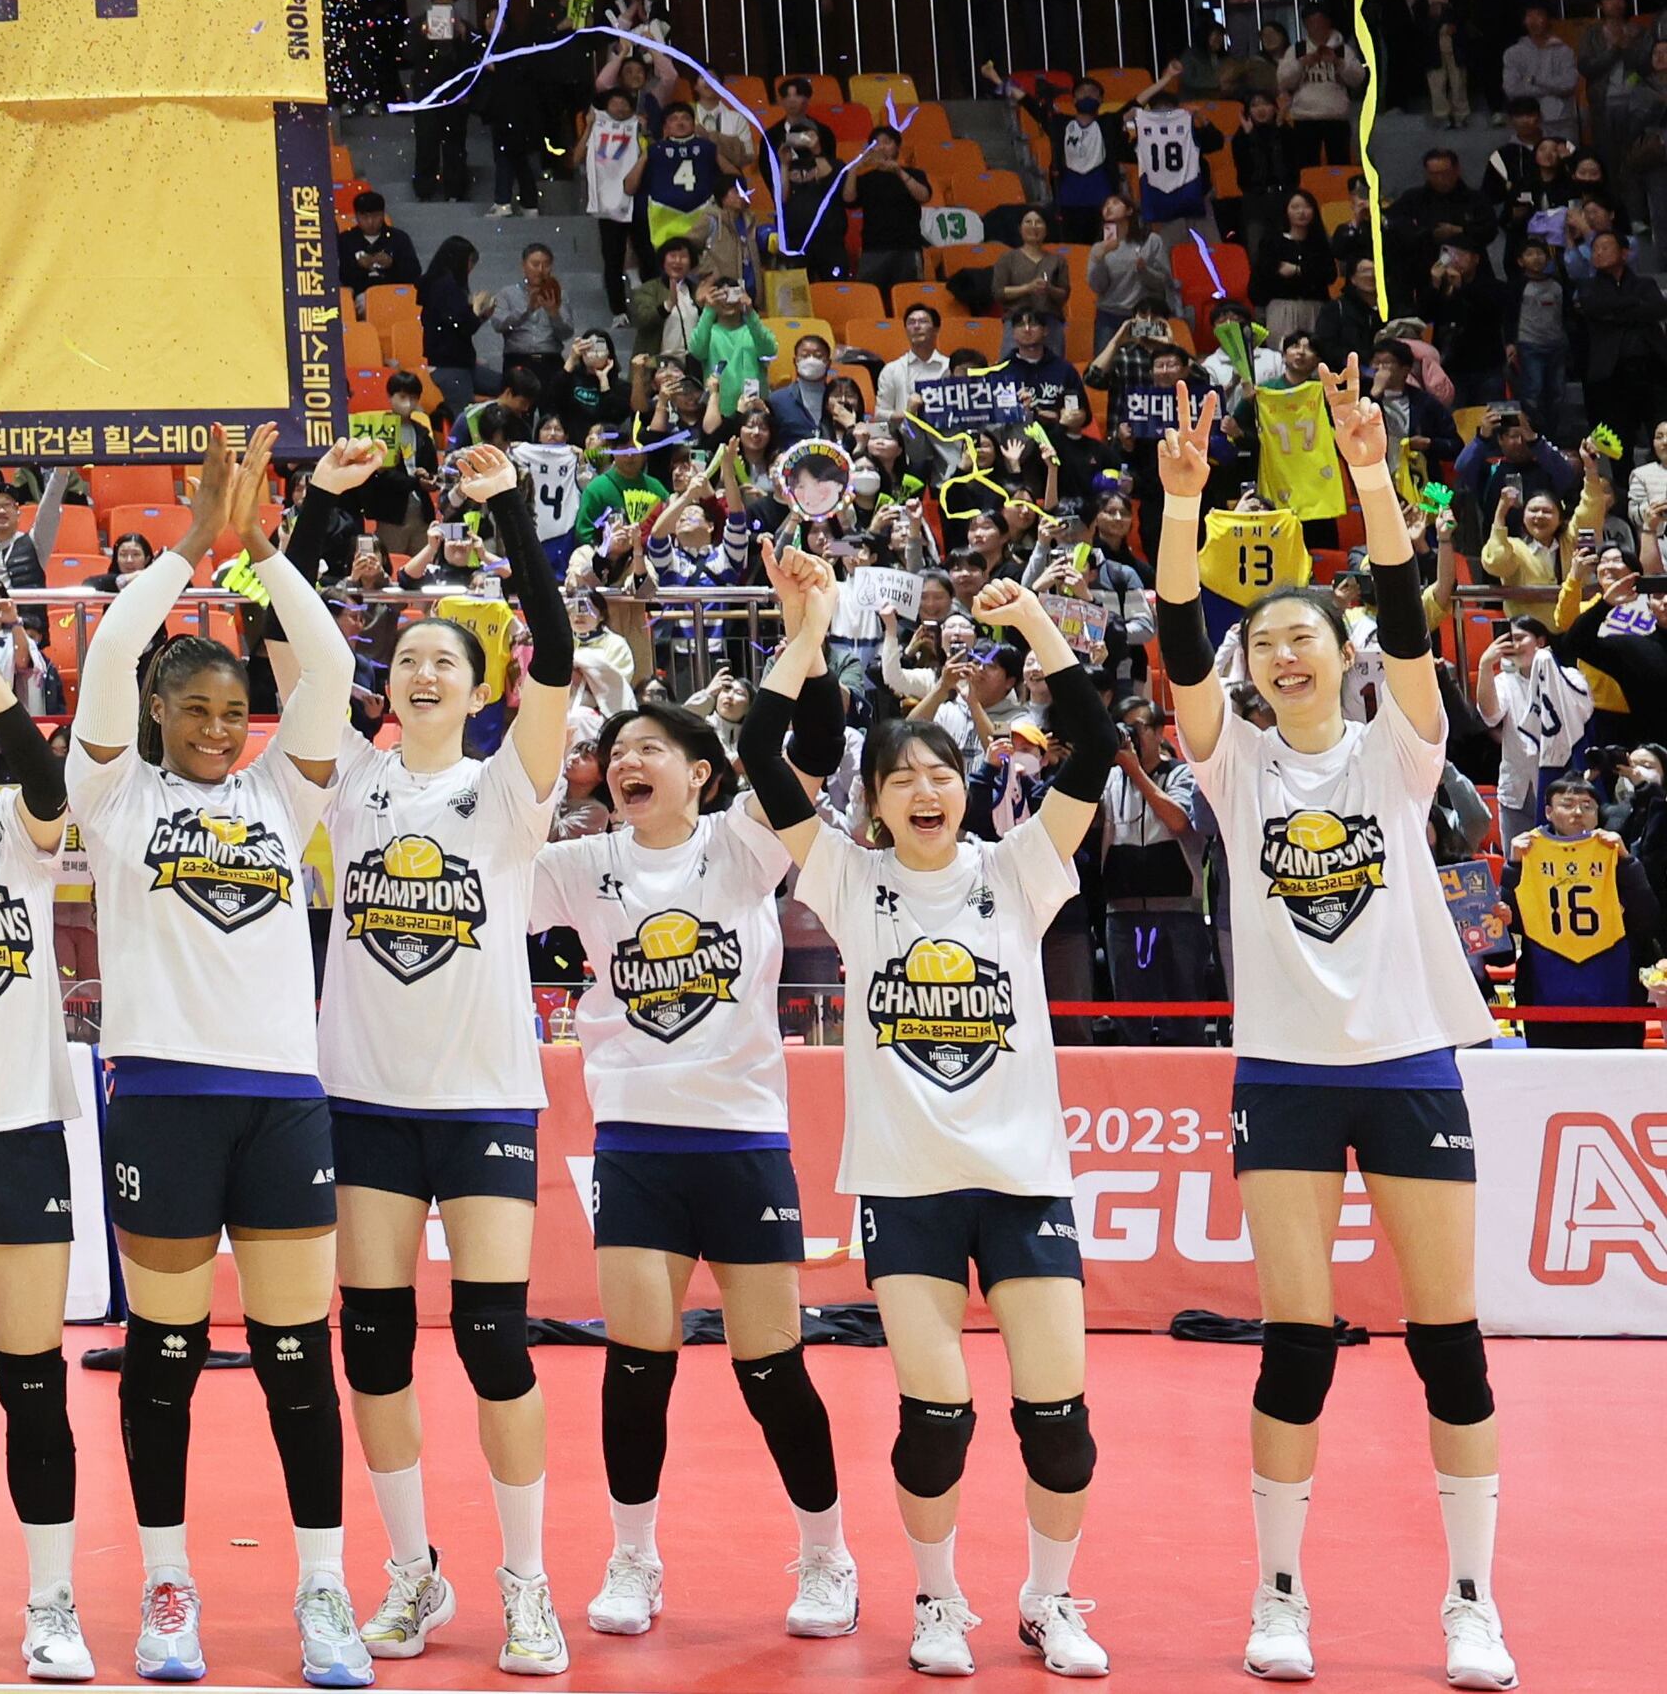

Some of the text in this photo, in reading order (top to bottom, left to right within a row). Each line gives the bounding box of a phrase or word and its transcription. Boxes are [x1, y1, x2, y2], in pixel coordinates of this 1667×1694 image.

[598, 132, 631, 161] 17
[1151, 142, 1183, 172] 18
[671, 160, 697, 192] 4
[935, 212, 968, 241] 13
[293, 184, 335, 448] 현대건설 힐스테이트
[921, 375, 1016, 412] 현대건설
[1238, 544, 1273, 586] 13
[181, 860, 217, 875] 23-24
[345, 870, 482, 913] CHAMPIONS
[1306, 875, 1357, 893] 정규리그
[208, 890, 246, 904] HILLSTATE
[1308, 902, 1348, 915] HILLSTATE
[395, 913, 441, 931] 정규리그
[1547, 884, 1598, 937] 16
[389, 941, 429, 955] HILLSTATE
[869, 980, 1011, 1019] CHAMPIONS
[900, 1022, 979, 1038] 23-24 정규리그
[929, 1050, 969, 1064] HILLSTATE
[504, 1142, 535, 1161] 현대건설
[115, 1163, 141, 1202] 99
[160, 1348, 187, 1359] errea
[276, 1350, 303, 1361] errea
